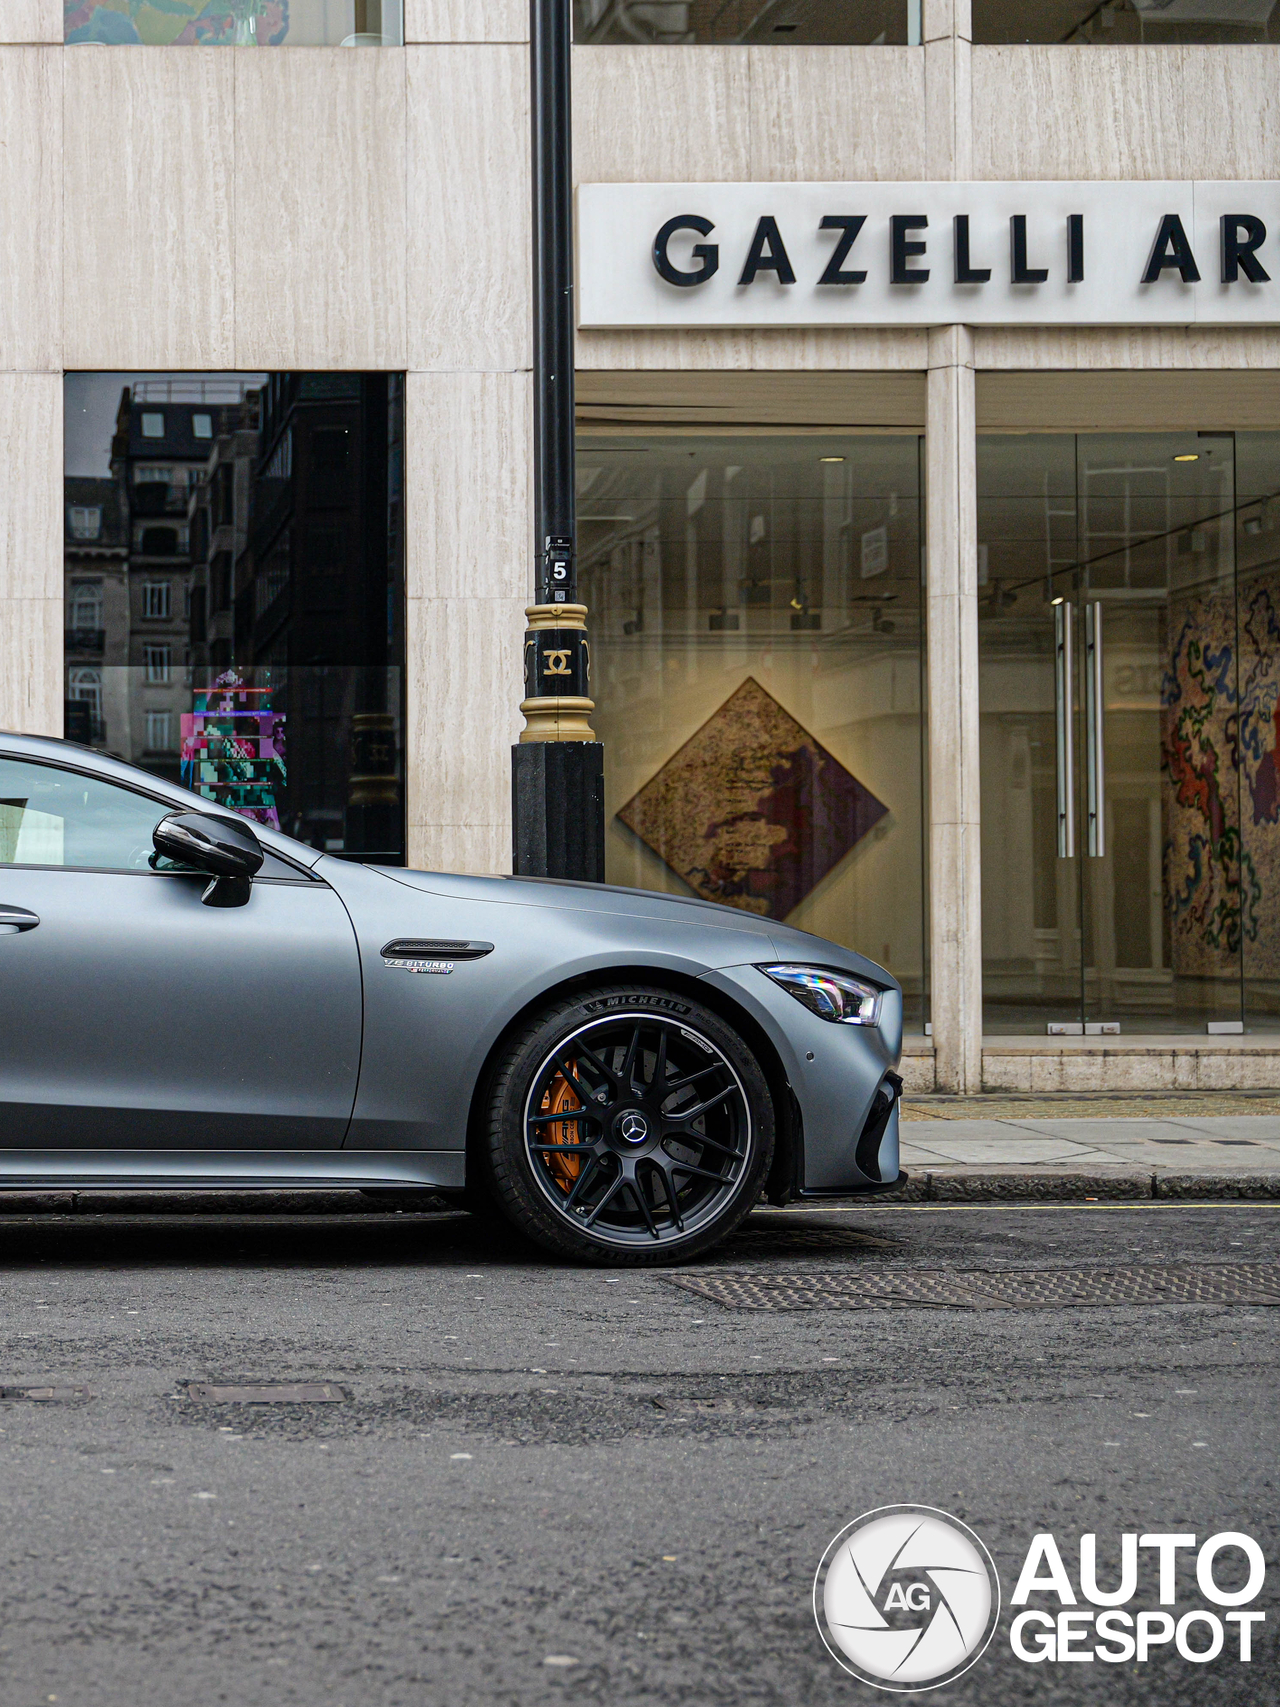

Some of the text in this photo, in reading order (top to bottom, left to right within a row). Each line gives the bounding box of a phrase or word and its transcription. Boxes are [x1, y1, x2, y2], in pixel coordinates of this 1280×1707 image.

[653, 214, 1084, 287] GAZELLI
[553, 561, 567, 580] 5
[406, 960, 455, 969] BITURBO
[606, 994, 688, 1014] MICHELIN
